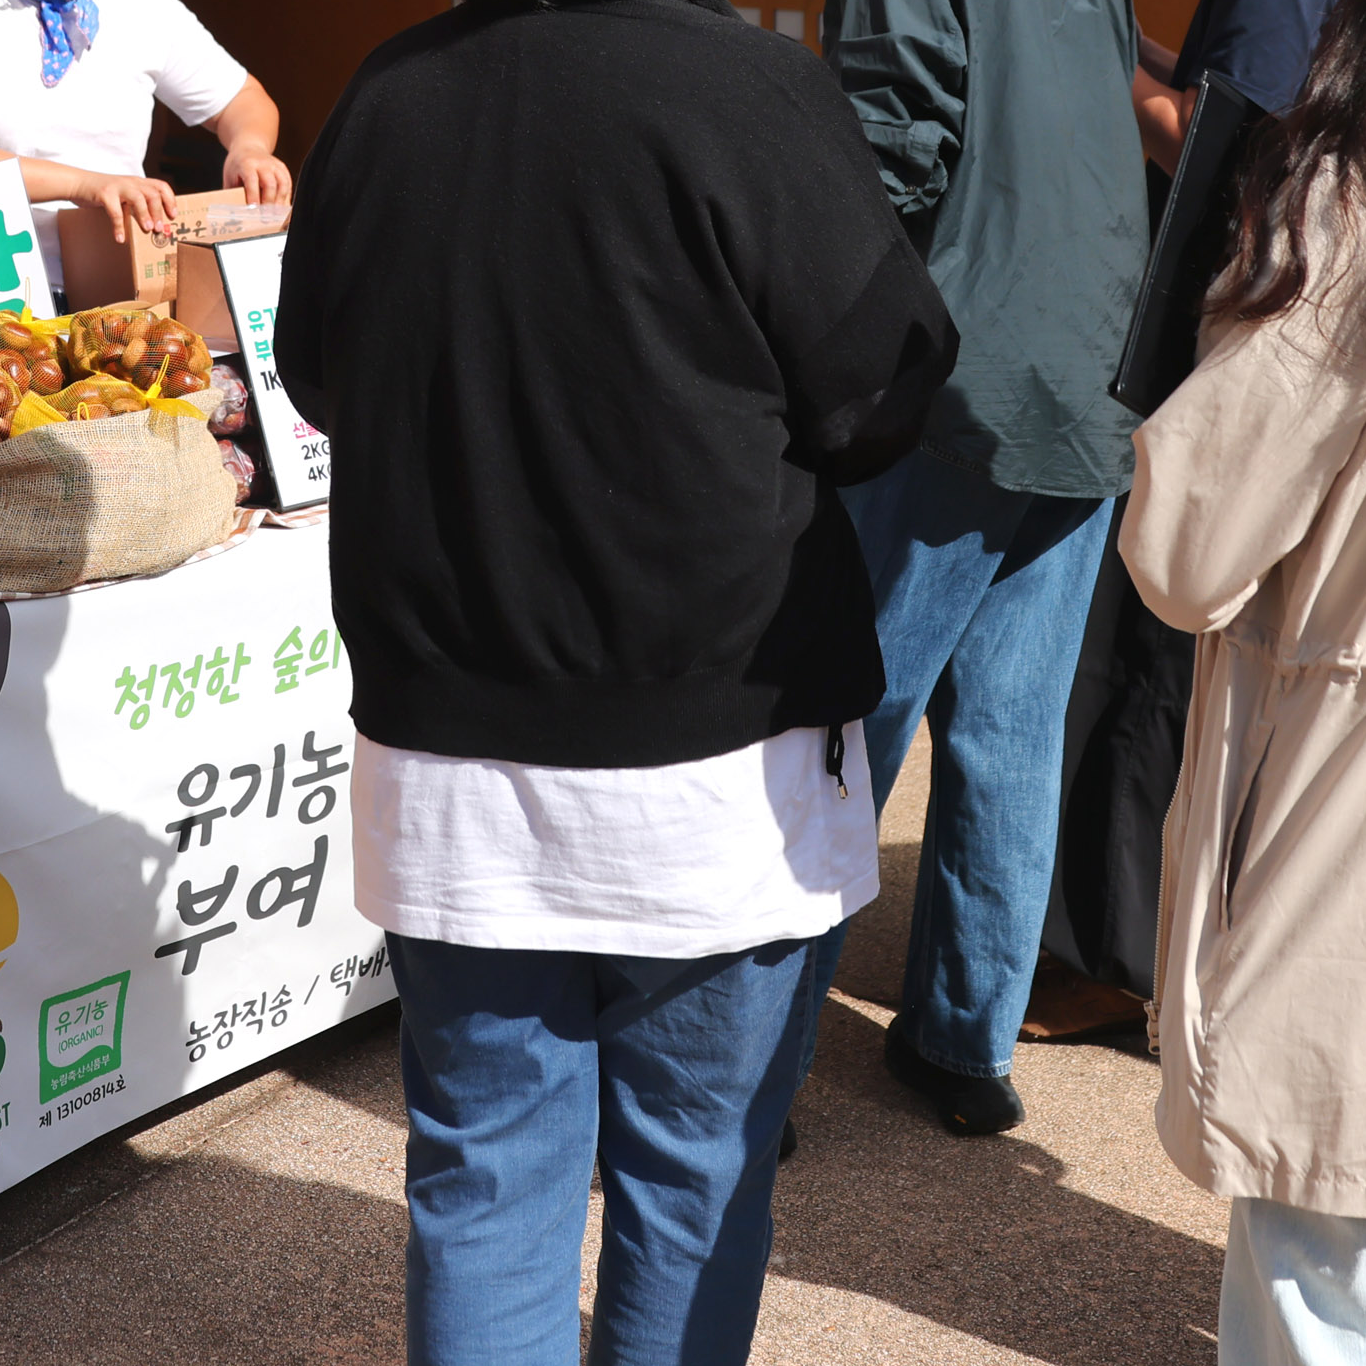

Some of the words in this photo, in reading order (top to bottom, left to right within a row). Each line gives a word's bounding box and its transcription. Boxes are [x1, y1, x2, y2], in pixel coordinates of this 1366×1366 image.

[114, 642, 252, 731] 청정한
[273, 625, 342, 694] 숲의
[165, 730, 350, 853] 유기농
[154, 834, 329, 976] 부여
[54, 1000, 109, 1036] 유기농
[58, 1024, 104, 1054] (ORGANIC)
[185, 984, 293, 1063] 농장직송
[330, 946, 391, 997] 택배
[38, 1110, 53, 1128] 제
[56, 1074, 127, 1121] 13100814호
[50, 1053, 111, 1091] 농림축산식품부
